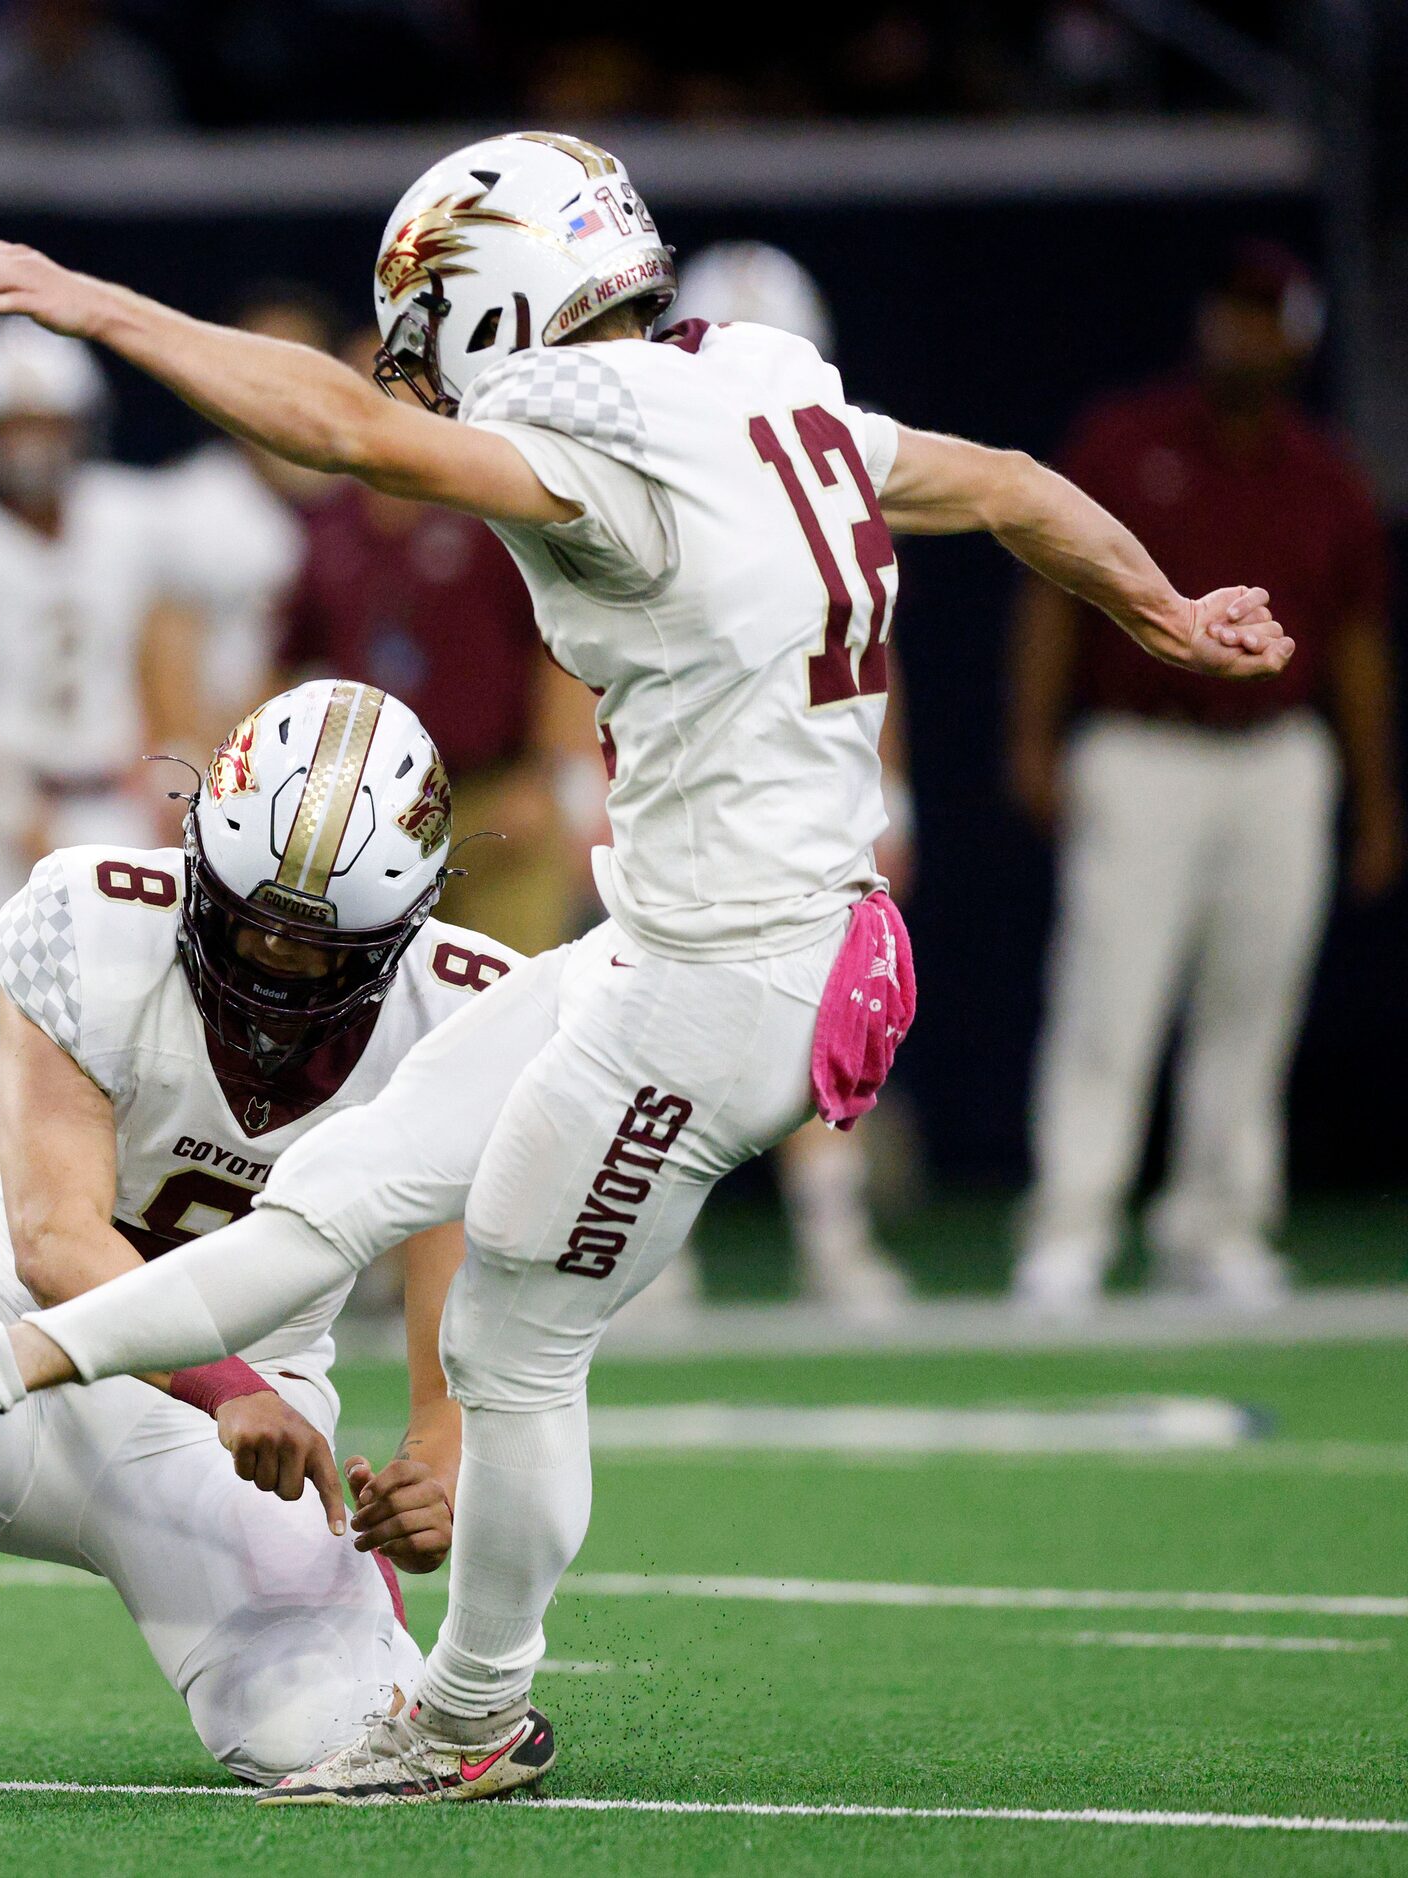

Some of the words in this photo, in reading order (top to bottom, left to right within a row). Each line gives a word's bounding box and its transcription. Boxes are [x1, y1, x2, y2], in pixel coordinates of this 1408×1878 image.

[595, 181, 655, 236] 12
[559, 295, 591, 330] OUR
[595, 259, 660, 304] HERITAGE
[746, 402, 897, 711] 12
[92, 859, 180, 911] 8
[263, 890, 329, 922] COYOTES
[253, 983, 288, 1000] Riddell
[429, 941, 511, 994] 8
[555, 1085, 693, 1280] COYOTES
